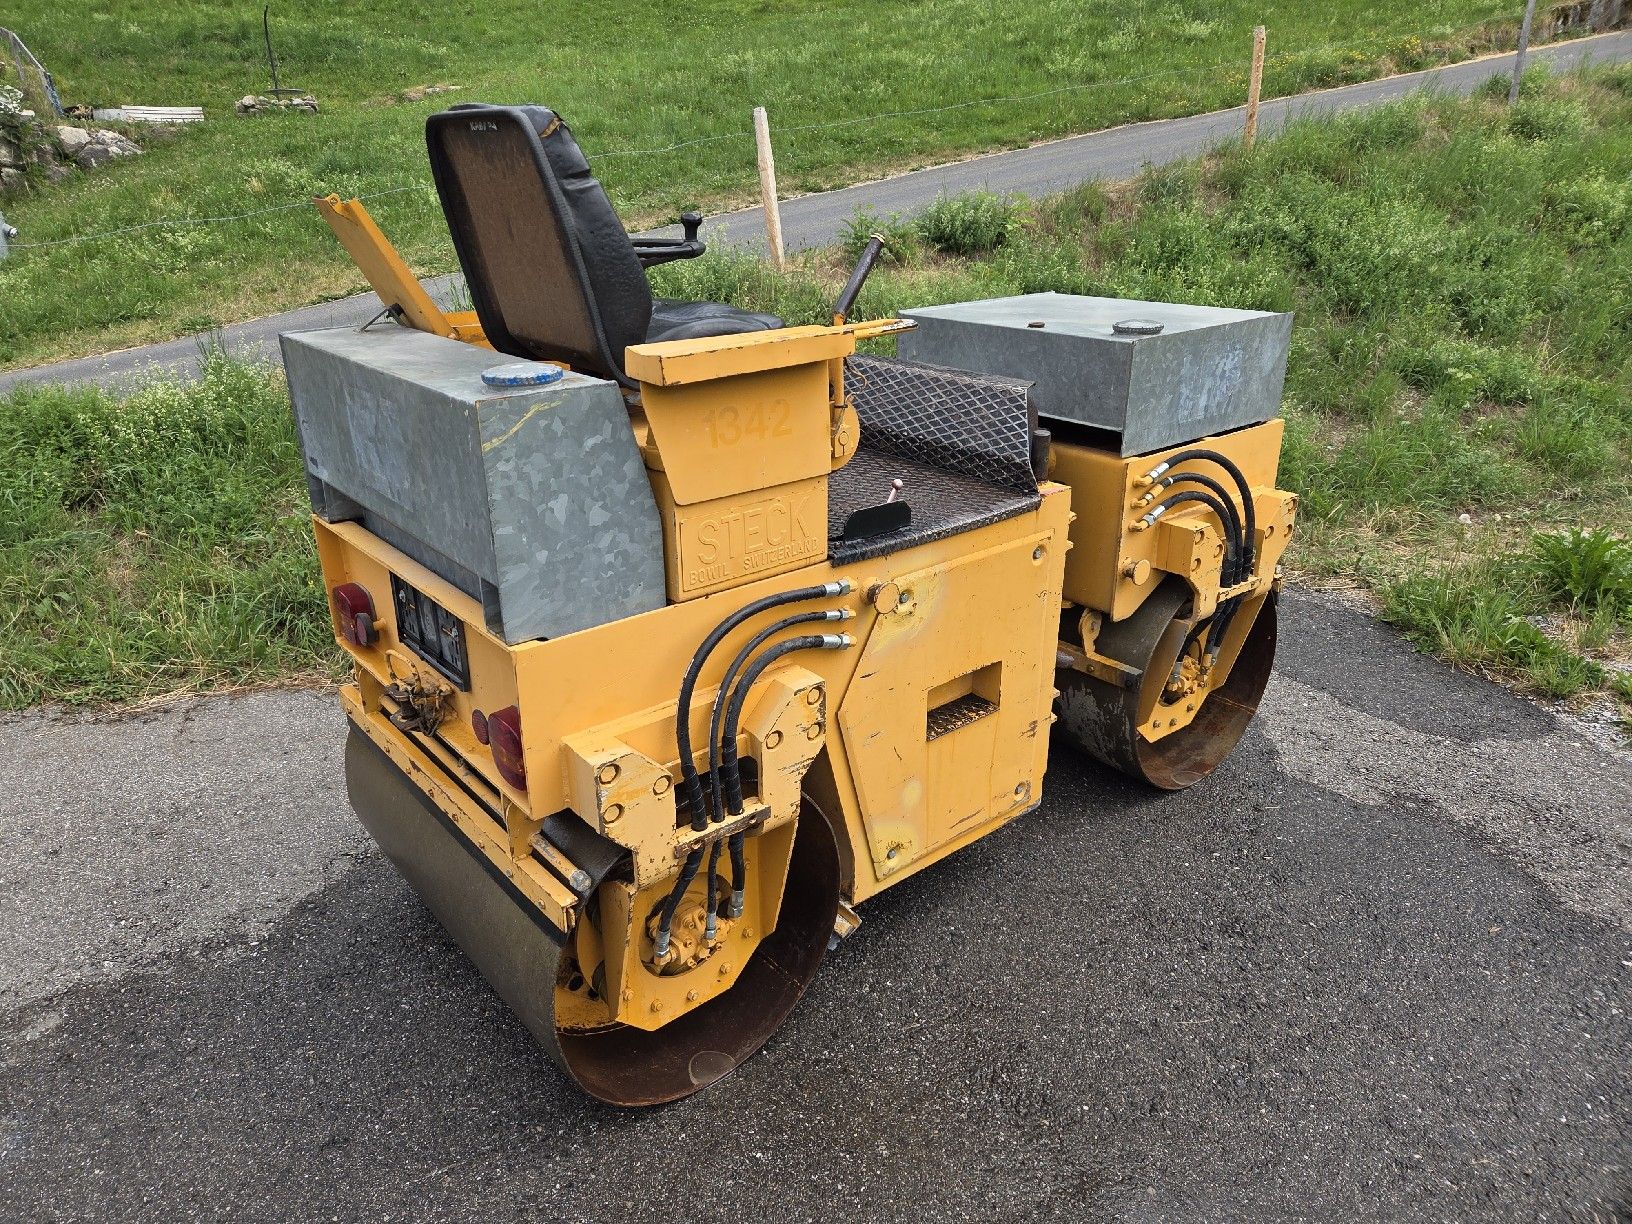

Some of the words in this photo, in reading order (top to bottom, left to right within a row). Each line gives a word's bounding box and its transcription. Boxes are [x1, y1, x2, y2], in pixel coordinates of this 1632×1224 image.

[703, 399, 793, 449] 1342
[697, 494, 811, 565] STECK
[743, 536, 819, 571] SWITZERLAND
